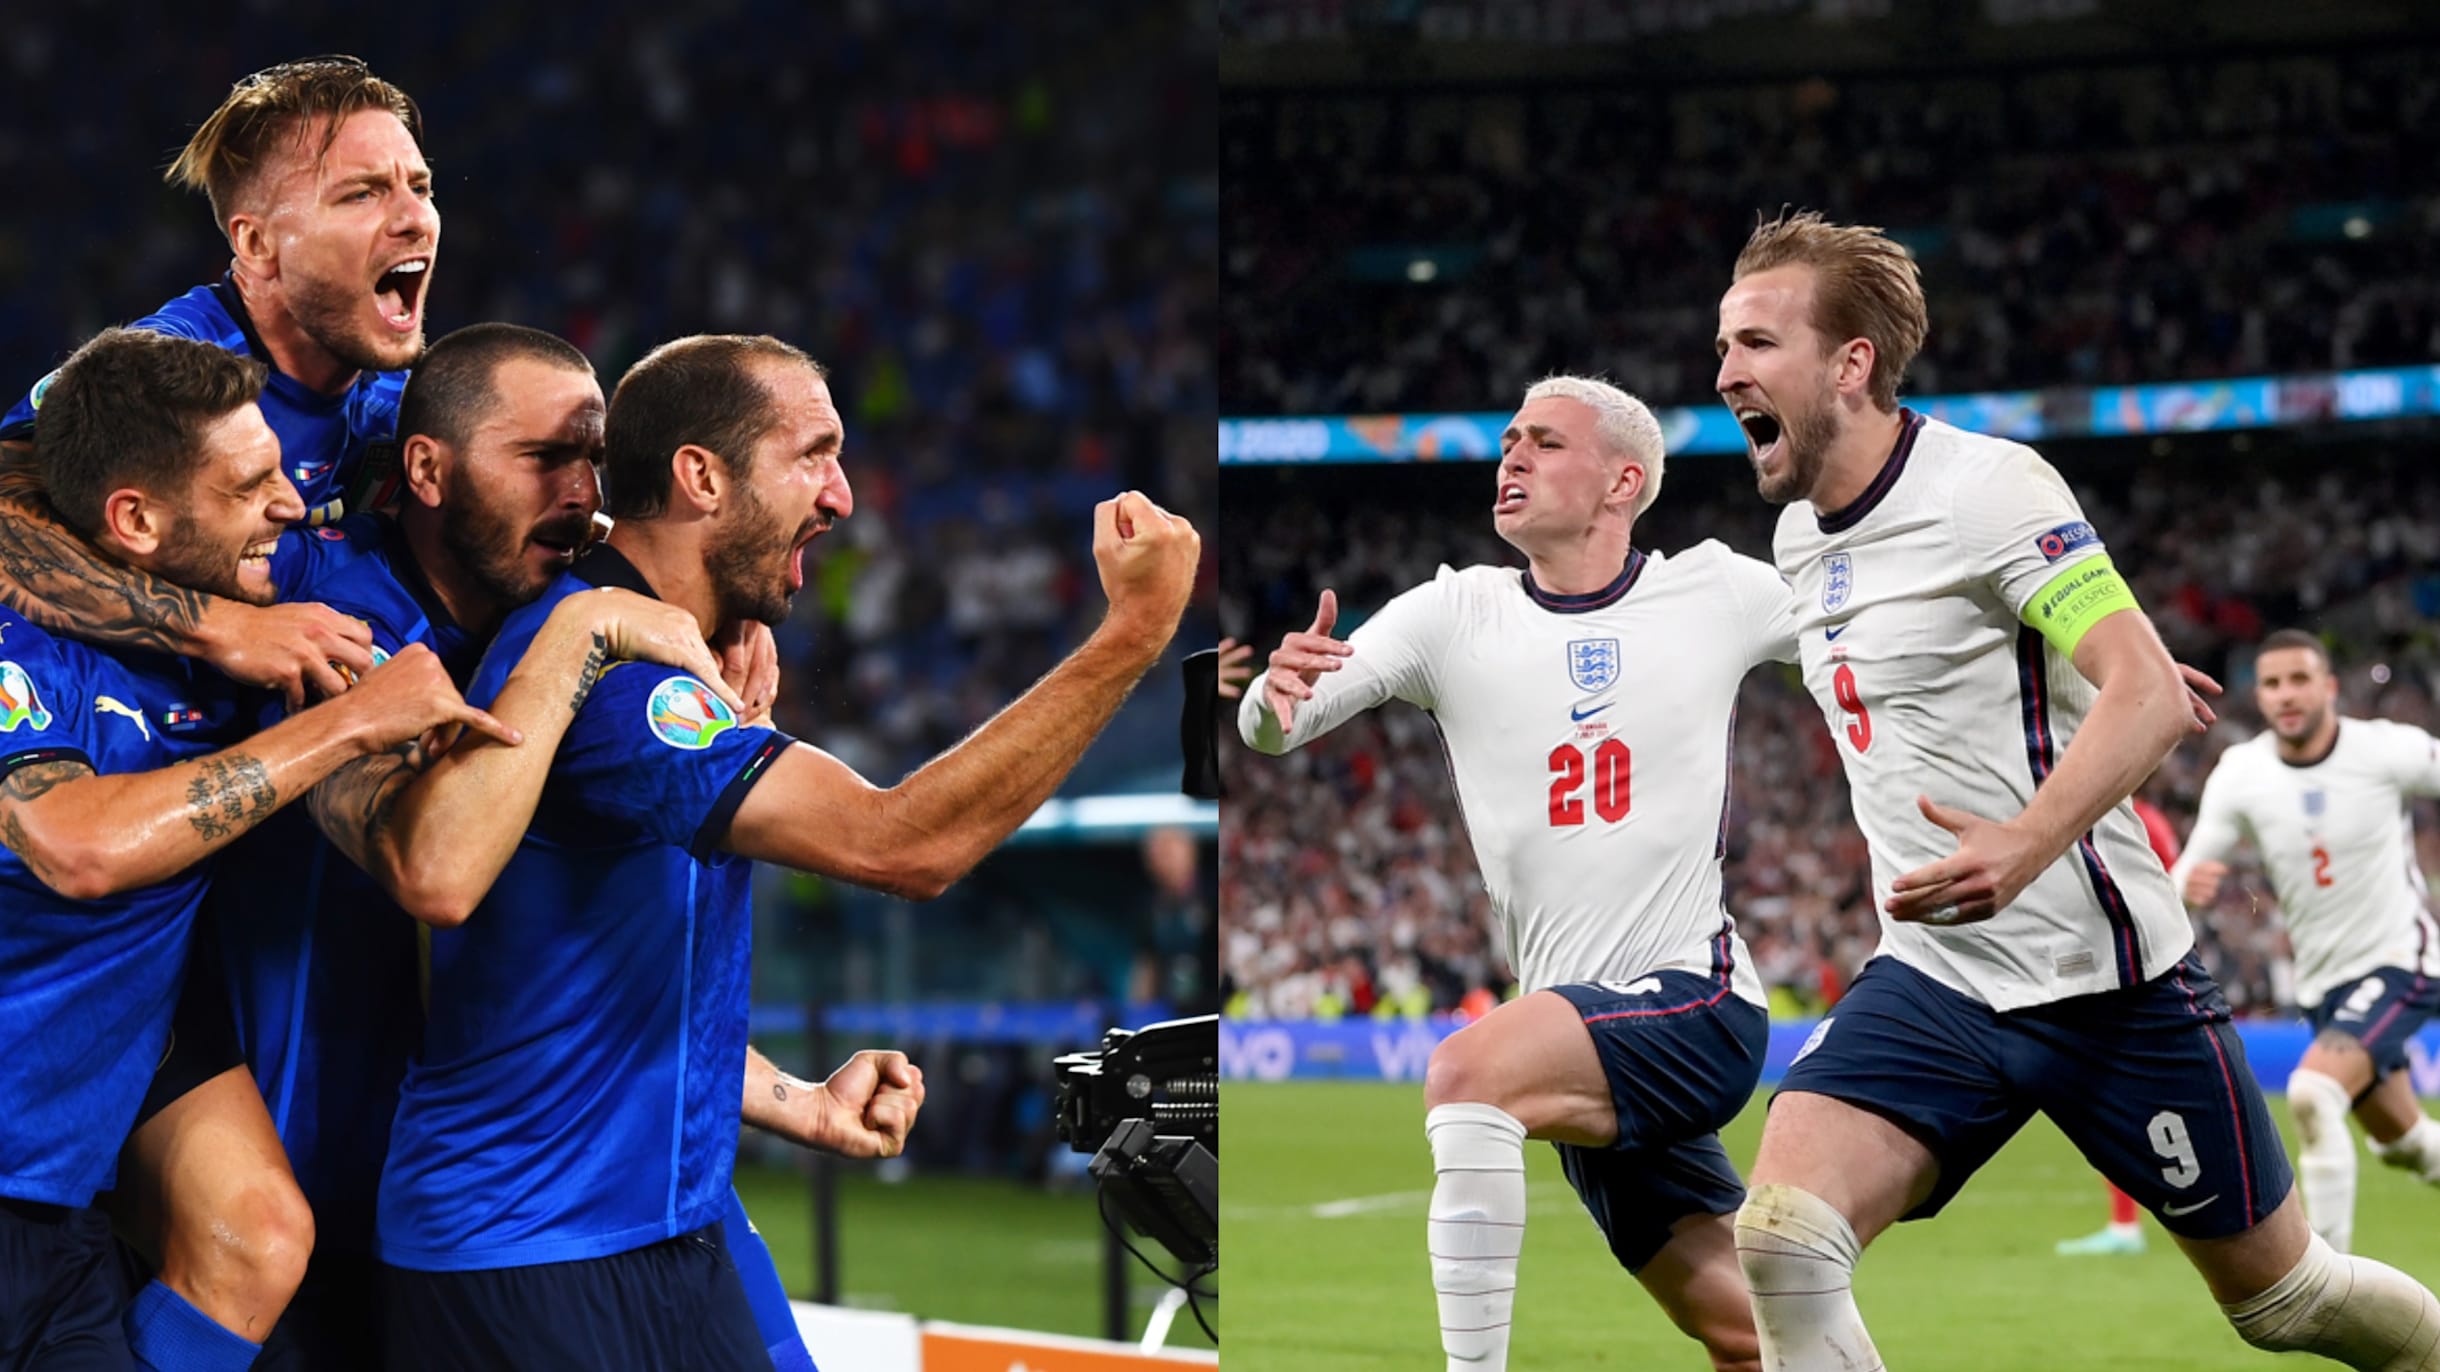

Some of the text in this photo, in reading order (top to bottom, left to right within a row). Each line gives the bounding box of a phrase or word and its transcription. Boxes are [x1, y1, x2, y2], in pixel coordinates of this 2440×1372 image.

[1833, 663, 1872, 754] 9
[1548, 738, 1631, 826] 20
[2311, 847, 2334, 887] 2
[2146, 1110, 2200, 1188] 9
